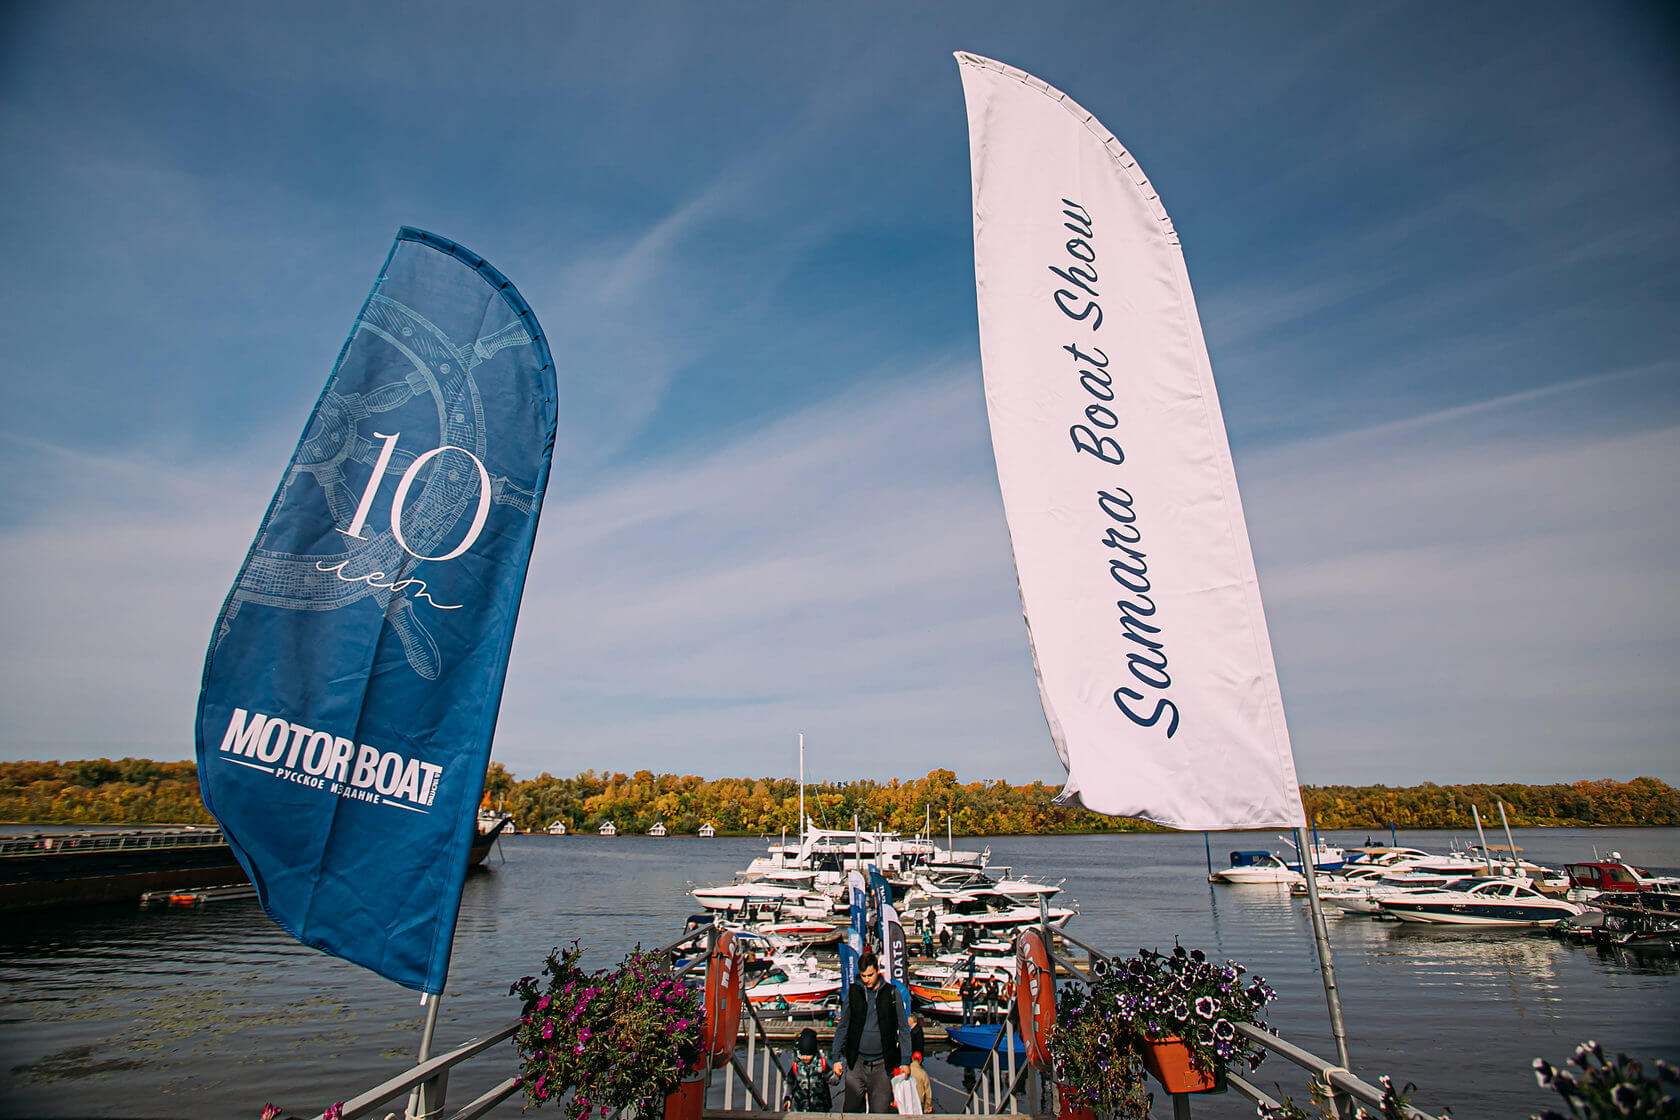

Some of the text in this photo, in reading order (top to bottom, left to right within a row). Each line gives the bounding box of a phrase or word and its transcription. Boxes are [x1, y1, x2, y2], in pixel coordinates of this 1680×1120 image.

[335, 431, 492, 561] 10
[1047, 197, 1180, 740] Samara Boat Show
[275, 767, 380, 804] РУССКОЕ ИЗДАНИЕ
